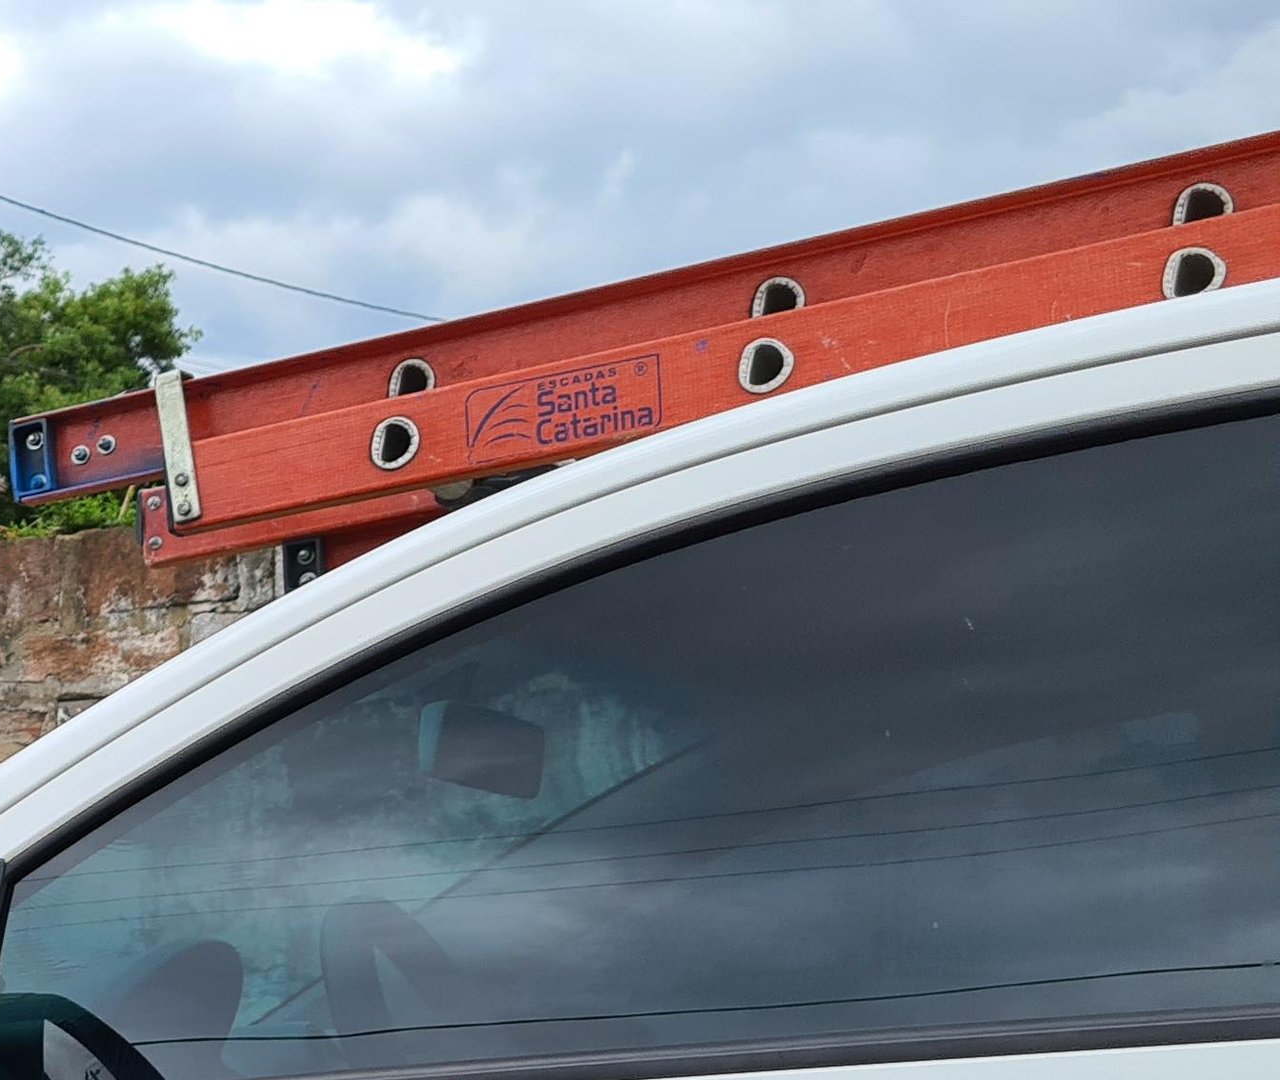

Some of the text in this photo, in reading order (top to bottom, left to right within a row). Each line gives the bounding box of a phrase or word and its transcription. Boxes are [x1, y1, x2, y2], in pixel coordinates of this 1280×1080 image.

[537, 368, 617, 391] ESCADAS
[537, 382, 617, 417] Santa
[536, 406, 653, 445] Catarina
